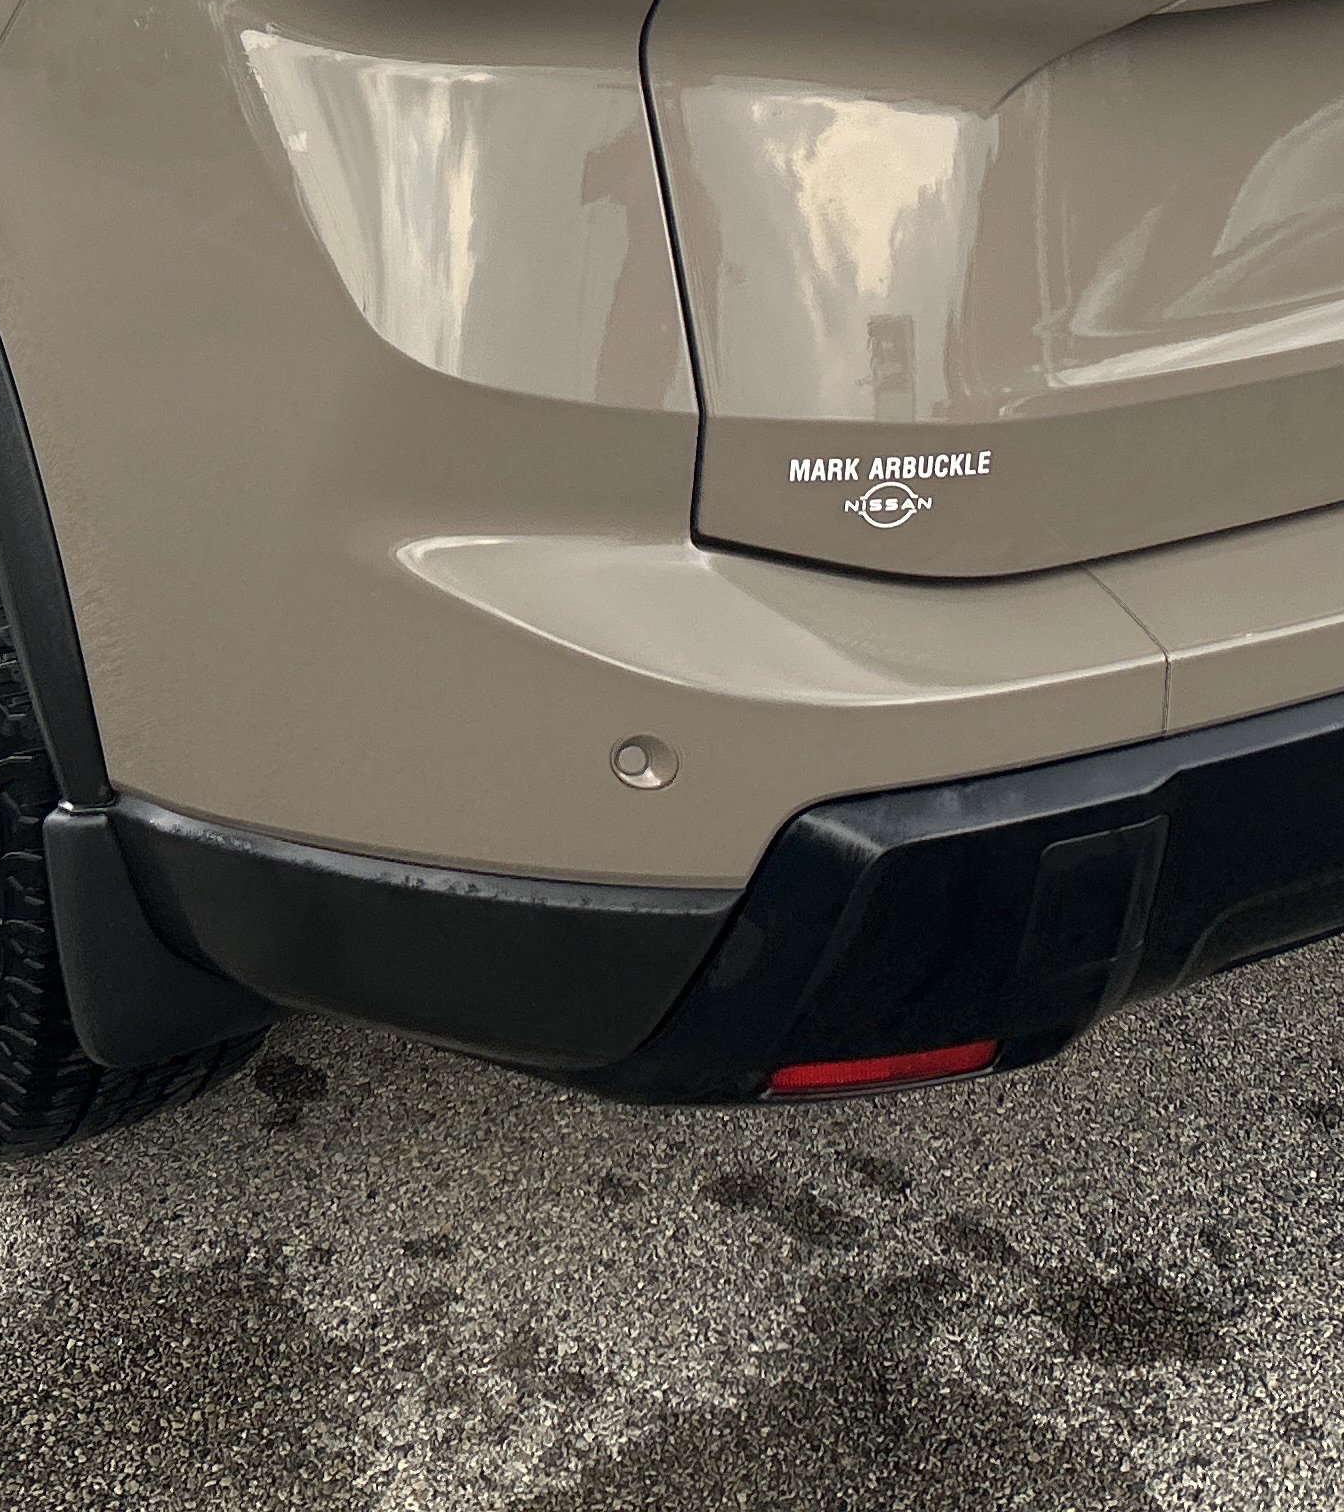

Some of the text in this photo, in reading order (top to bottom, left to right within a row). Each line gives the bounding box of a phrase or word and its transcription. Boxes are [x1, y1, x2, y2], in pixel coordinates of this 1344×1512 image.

[789, 451, 991, 481] MARK ARBUCKLE
[844, 497, 932, 512] NISSAN
